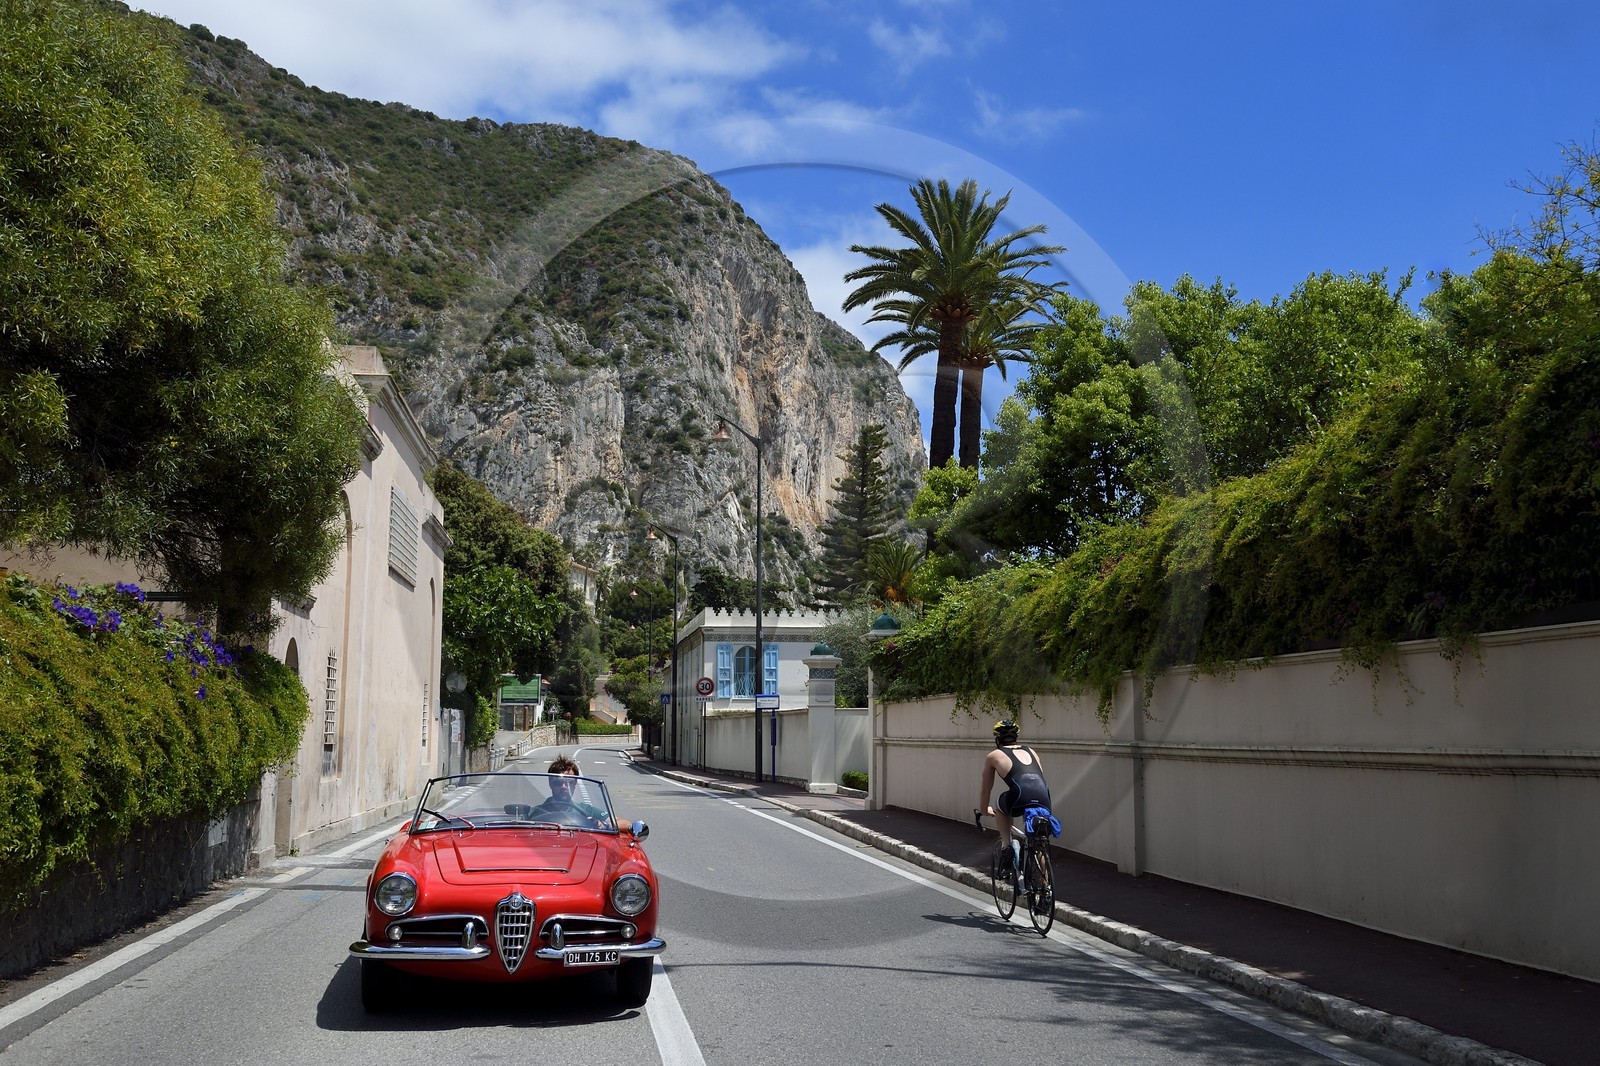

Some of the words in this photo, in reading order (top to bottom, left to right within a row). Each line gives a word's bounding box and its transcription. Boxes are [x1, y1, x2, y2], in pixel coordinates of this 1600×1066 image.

[700, 682, 710, 690] 30
[568, 953, 580, 963] DH
[585, 952, 600, 962] 175
[605, 951, 617, 961] KC
